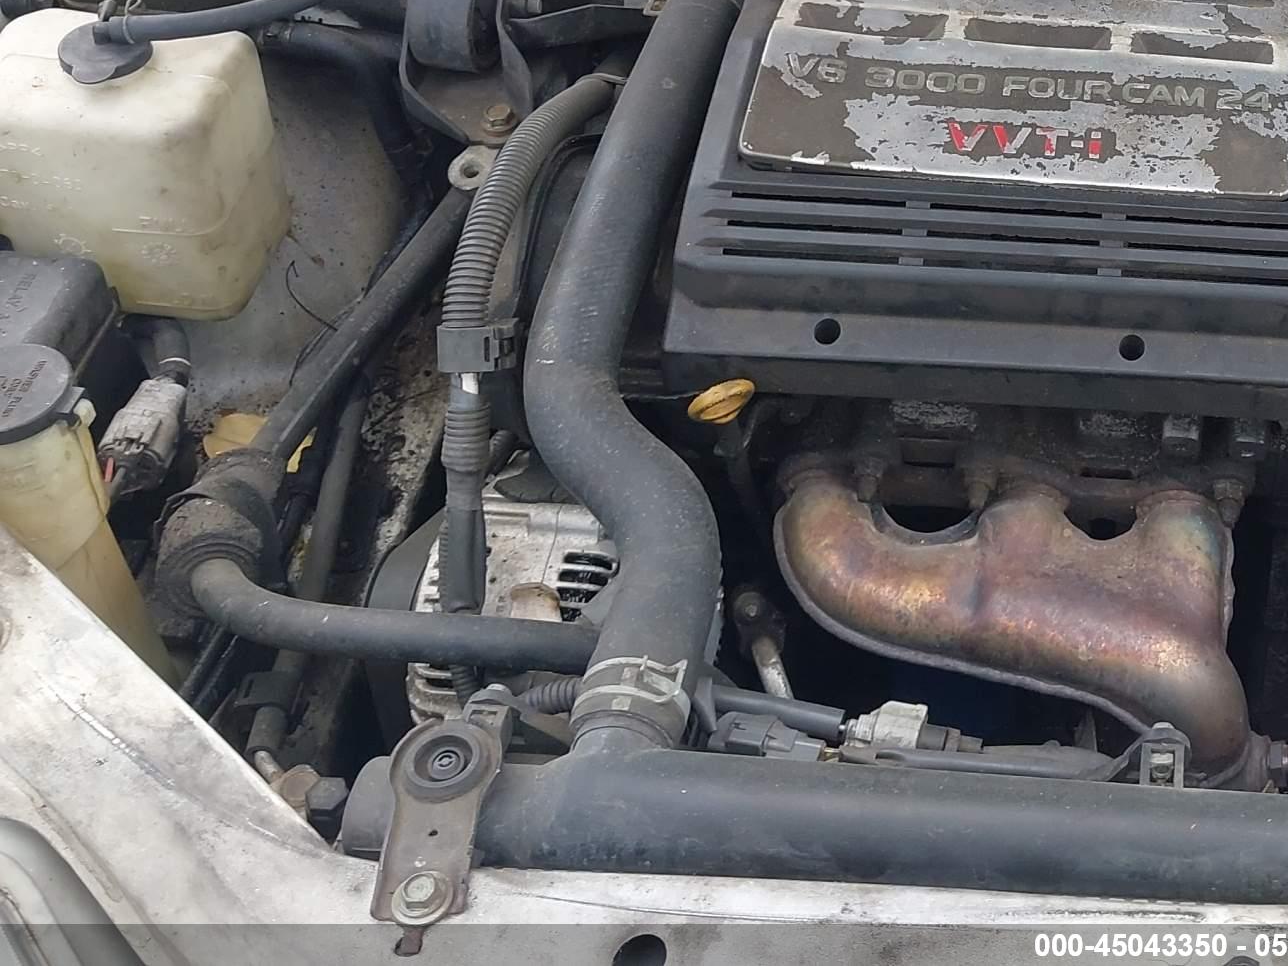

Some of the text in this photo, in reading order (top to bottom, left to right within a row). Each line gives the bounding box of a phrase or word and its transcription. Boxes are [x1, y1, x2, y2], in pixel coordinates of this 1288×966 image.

[786, 53, 1273, 112] V6 3000 FOUR CAM 24
